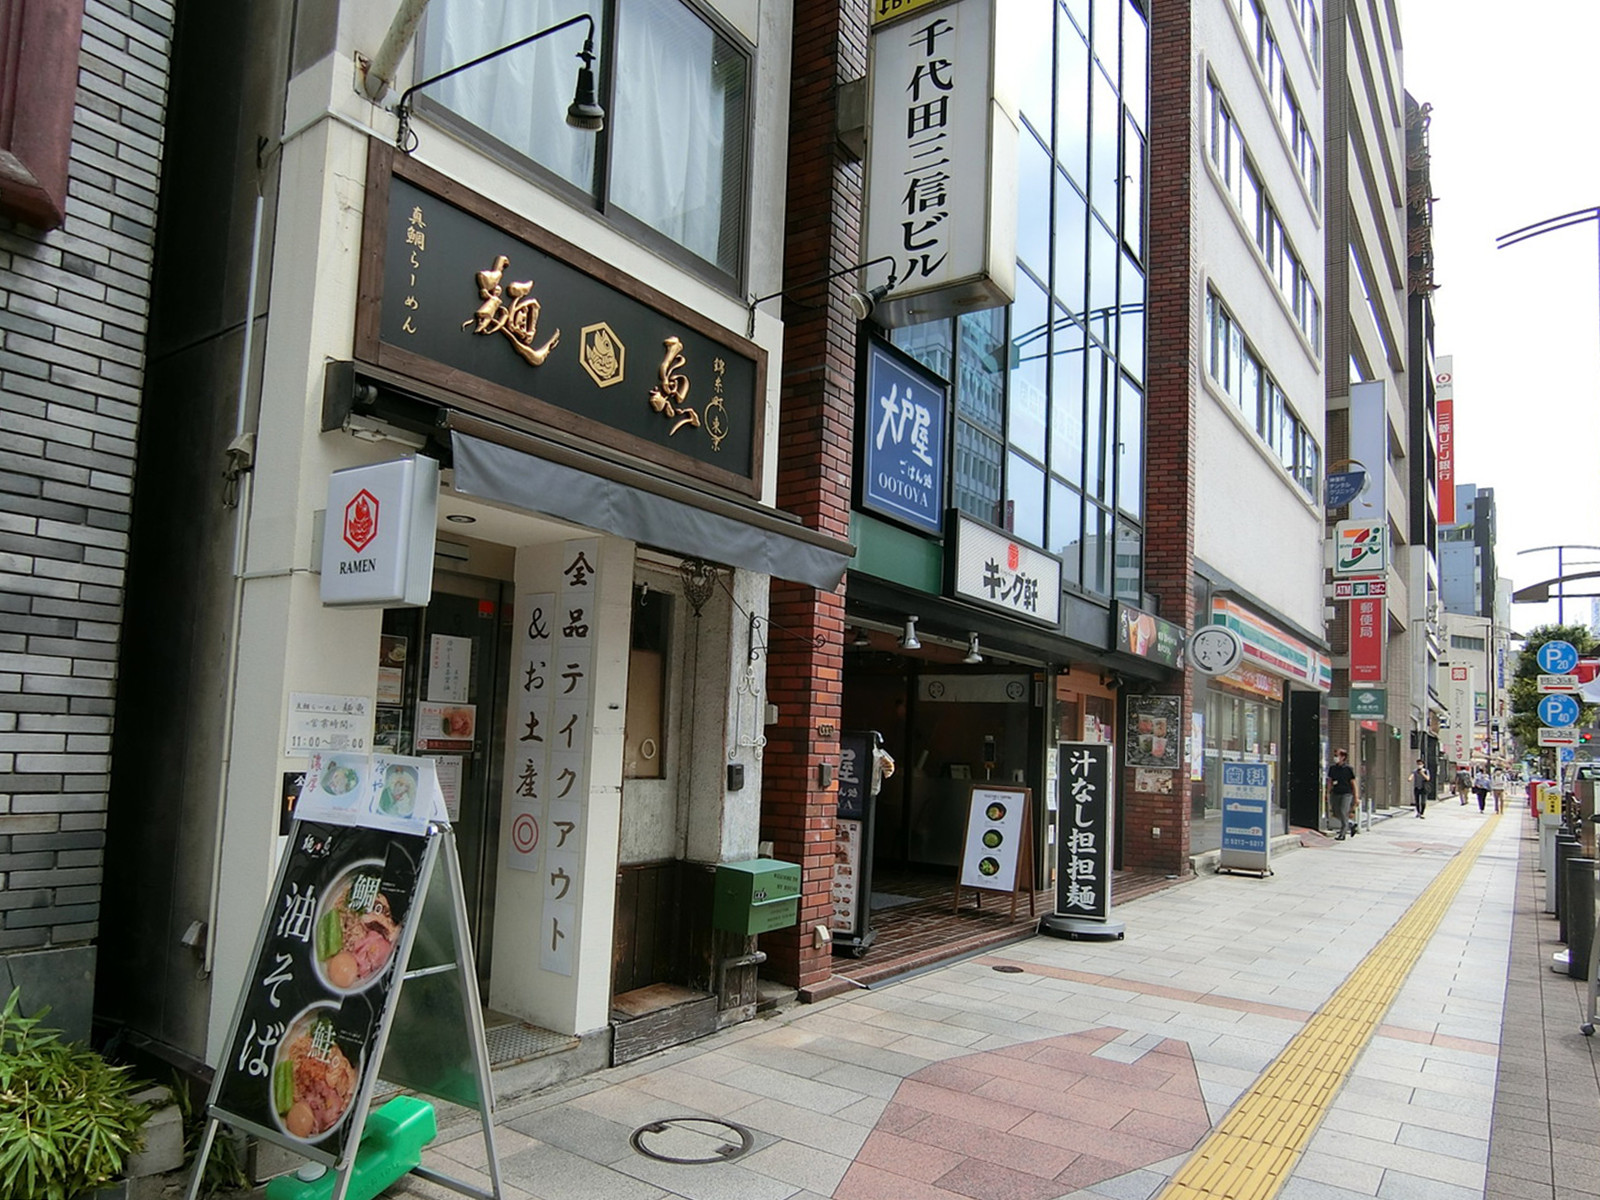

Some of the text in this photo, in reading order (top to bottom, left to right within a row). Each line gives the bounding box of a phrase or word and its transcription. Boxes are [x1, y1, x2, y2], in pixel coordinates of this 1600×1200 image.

[899, 18, 954, 286] 千代田三信ビル
[402, 205, 427, 335] 真鯛らーめん
[875, 382, 933, 468] 大戸屋
[1438, 412, 1450, 481] 三菱UFJ銀行
[878, 471, 929, 508] OOTOYA
[899, 459, 933, 490] ごはん処
[339, 557, 377, 575] RAMEN
[982, 557, 1039, 613] キング軒
[1336, 584, 1352, 596] ATM
[1360, 601, 1373, 638] 郵便局
[1546, 648, 1562, 669] P
[1556, 659, 1569, 670] 20
[1547, 701, 1563, 722] P
[1557, 712, 1570, 723] 40
[550, 550, 595, 952] 全品テイクアウト
[306, 753, 322, 794] 濃厚
[368, 758, 388, 814] 冷やし
[1226, 766, 1265, 786] 歯科
[1066, 750, 1098, 911] 汁なし担担麺
[239, 881, 317, 1078] 油そば
